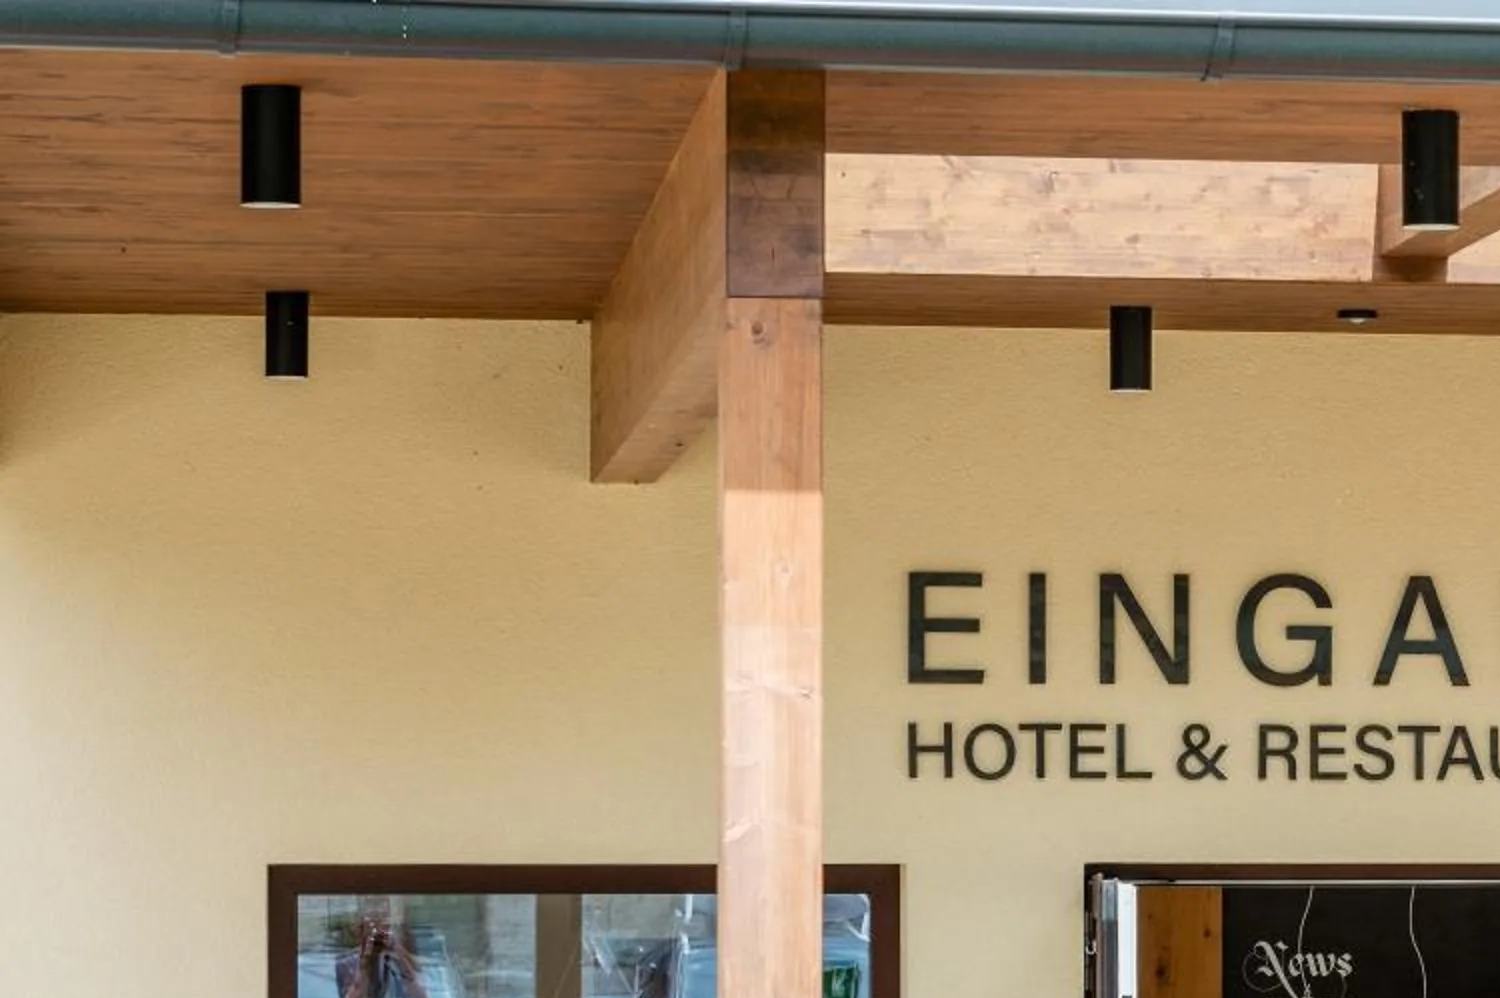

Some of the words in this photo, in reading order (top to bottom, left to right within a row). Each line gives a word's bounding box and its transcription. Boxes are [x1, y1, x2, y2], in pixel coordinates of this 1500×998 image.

[908, 722, 1152, 780] HOTEL
[1177, 724, 1227, 780] &
[1248, 940, 1353, 998] News
